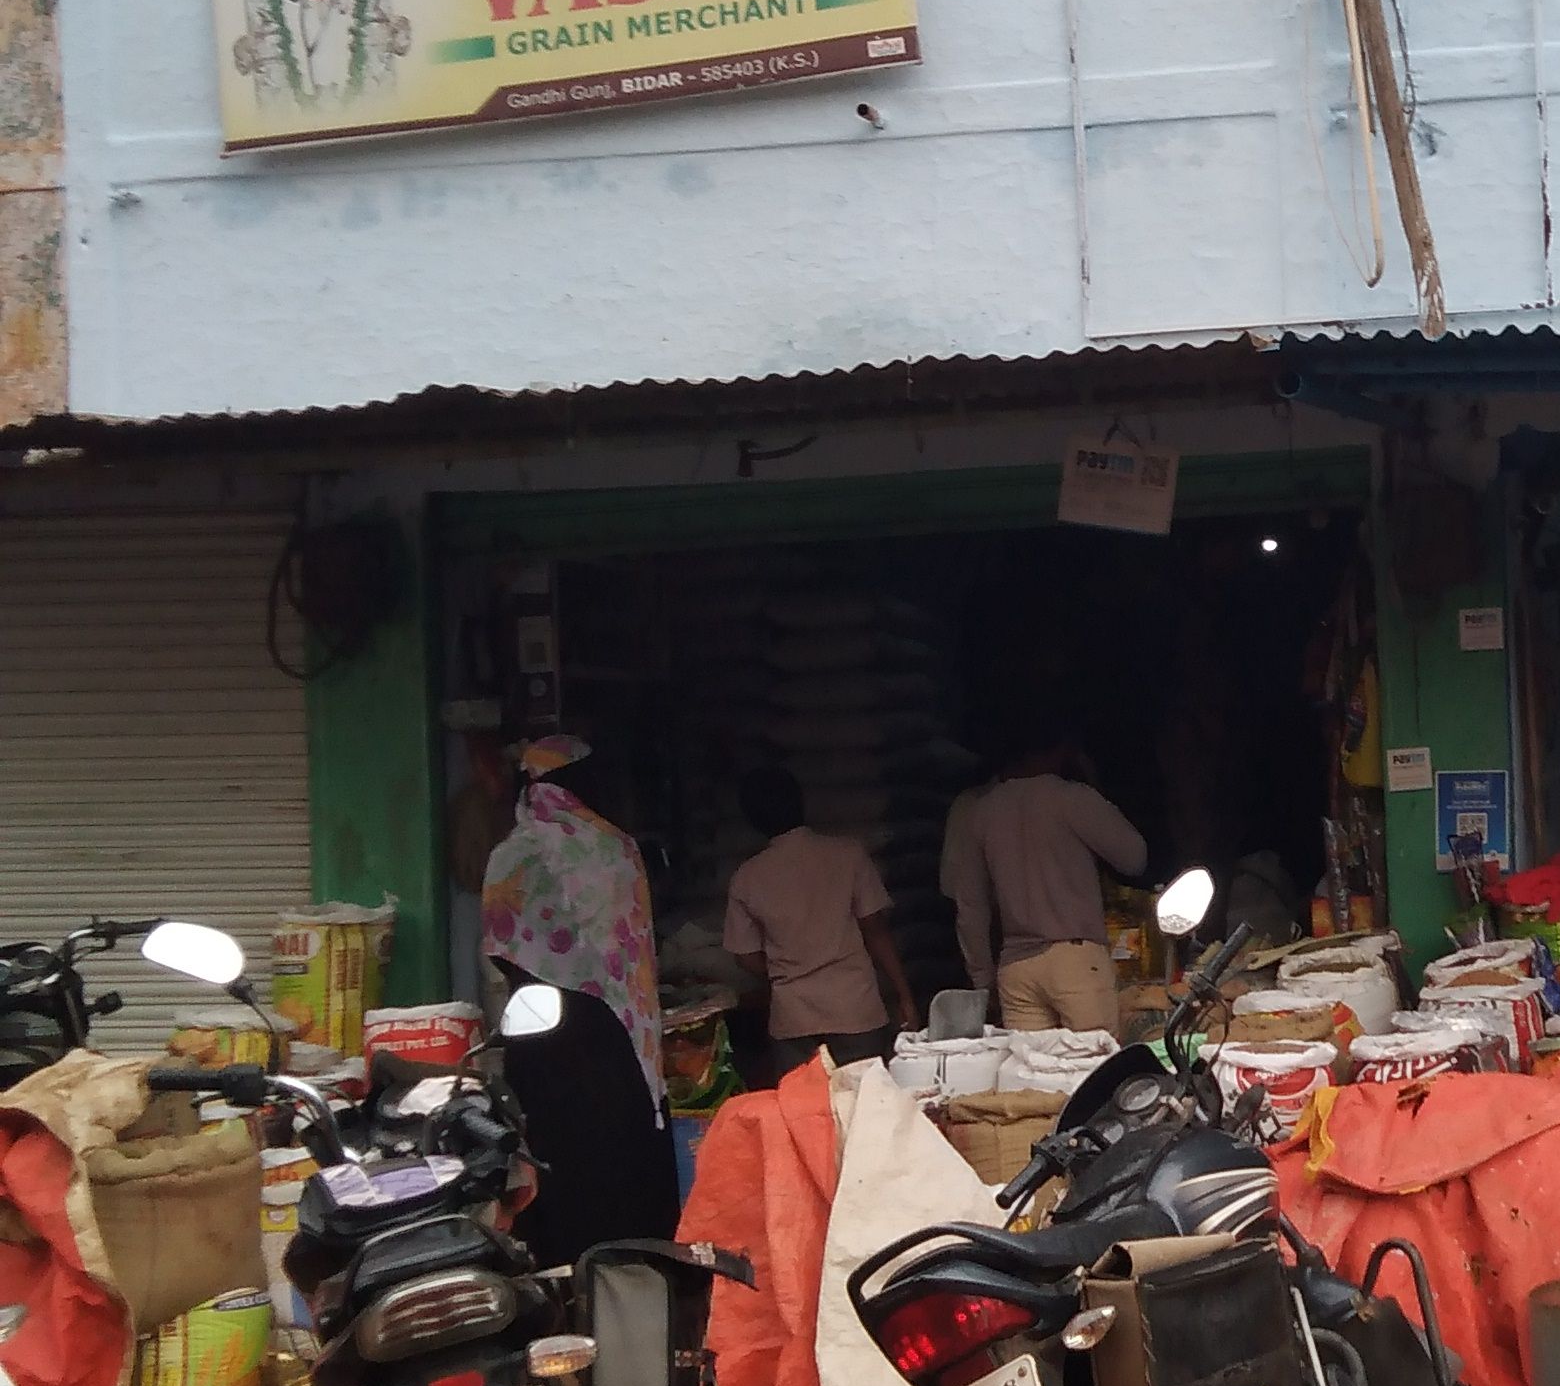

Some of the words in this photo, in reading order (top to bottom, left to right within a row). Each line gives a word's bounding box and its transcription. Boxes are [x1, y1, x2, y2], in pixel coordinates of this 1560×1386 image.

[507, 19, 614, 55] GRAIN
[506, 88, 567, 109] Gandhi
[620, 72, 683, 93] BIDAR
[700, 58, 764, 82] 585403
[768, 49, 820, 75] (K.S.)
